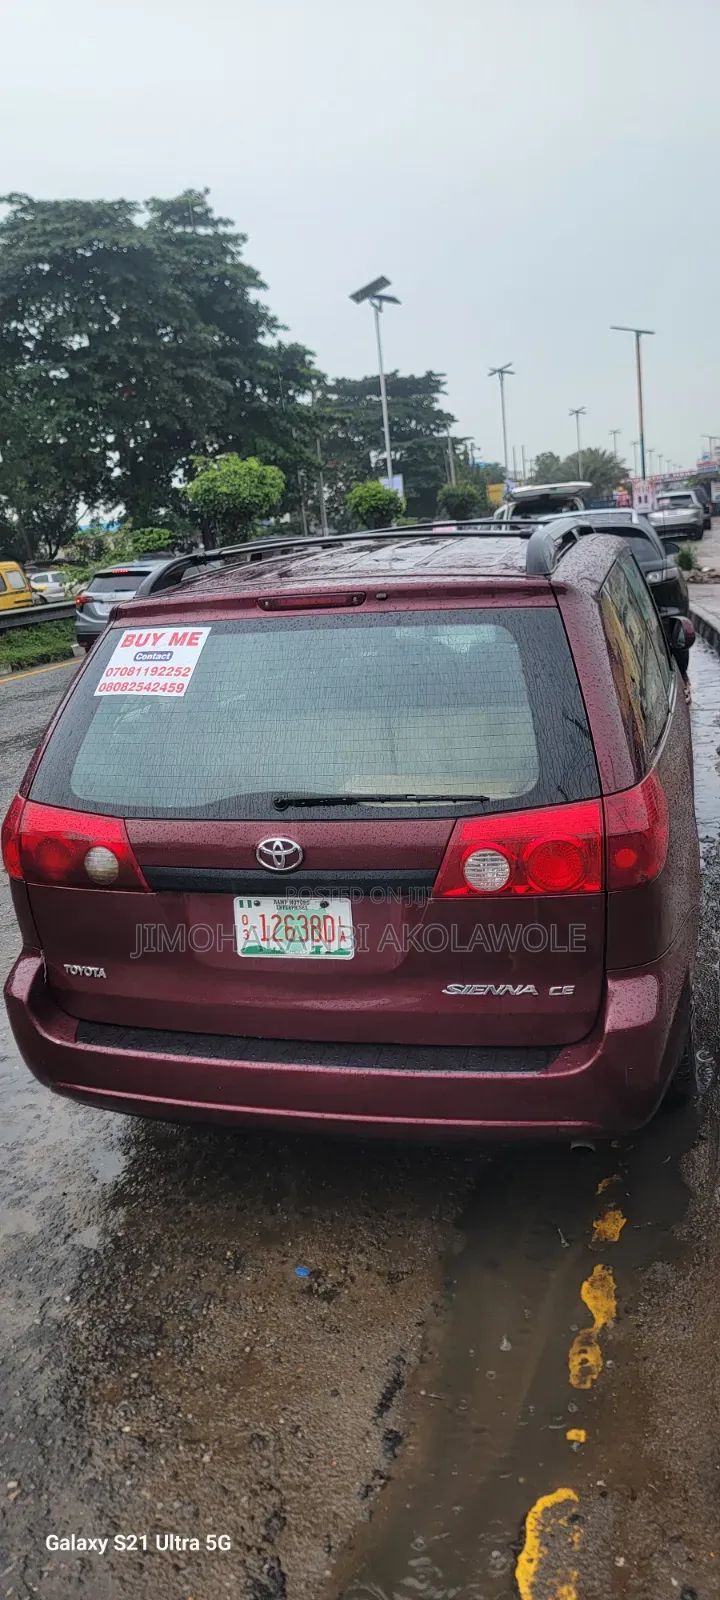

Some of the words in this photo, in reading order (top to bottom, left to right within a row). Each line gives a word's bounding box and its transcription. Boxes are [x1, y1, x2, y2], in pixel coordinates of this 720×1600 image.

[120, 632, 165, 648] BUY
[168, 631, 203, 647] ME
[135, 652, 171, 661] Contact
[105, 666, 191, 678] 07081192252
[98, 682, 185, 693] 08082542459
[63, 964, 107, 979] TOYOTA
[442, 983, 539, 996] SIENNA
[548, 985, 575, 996] CE
